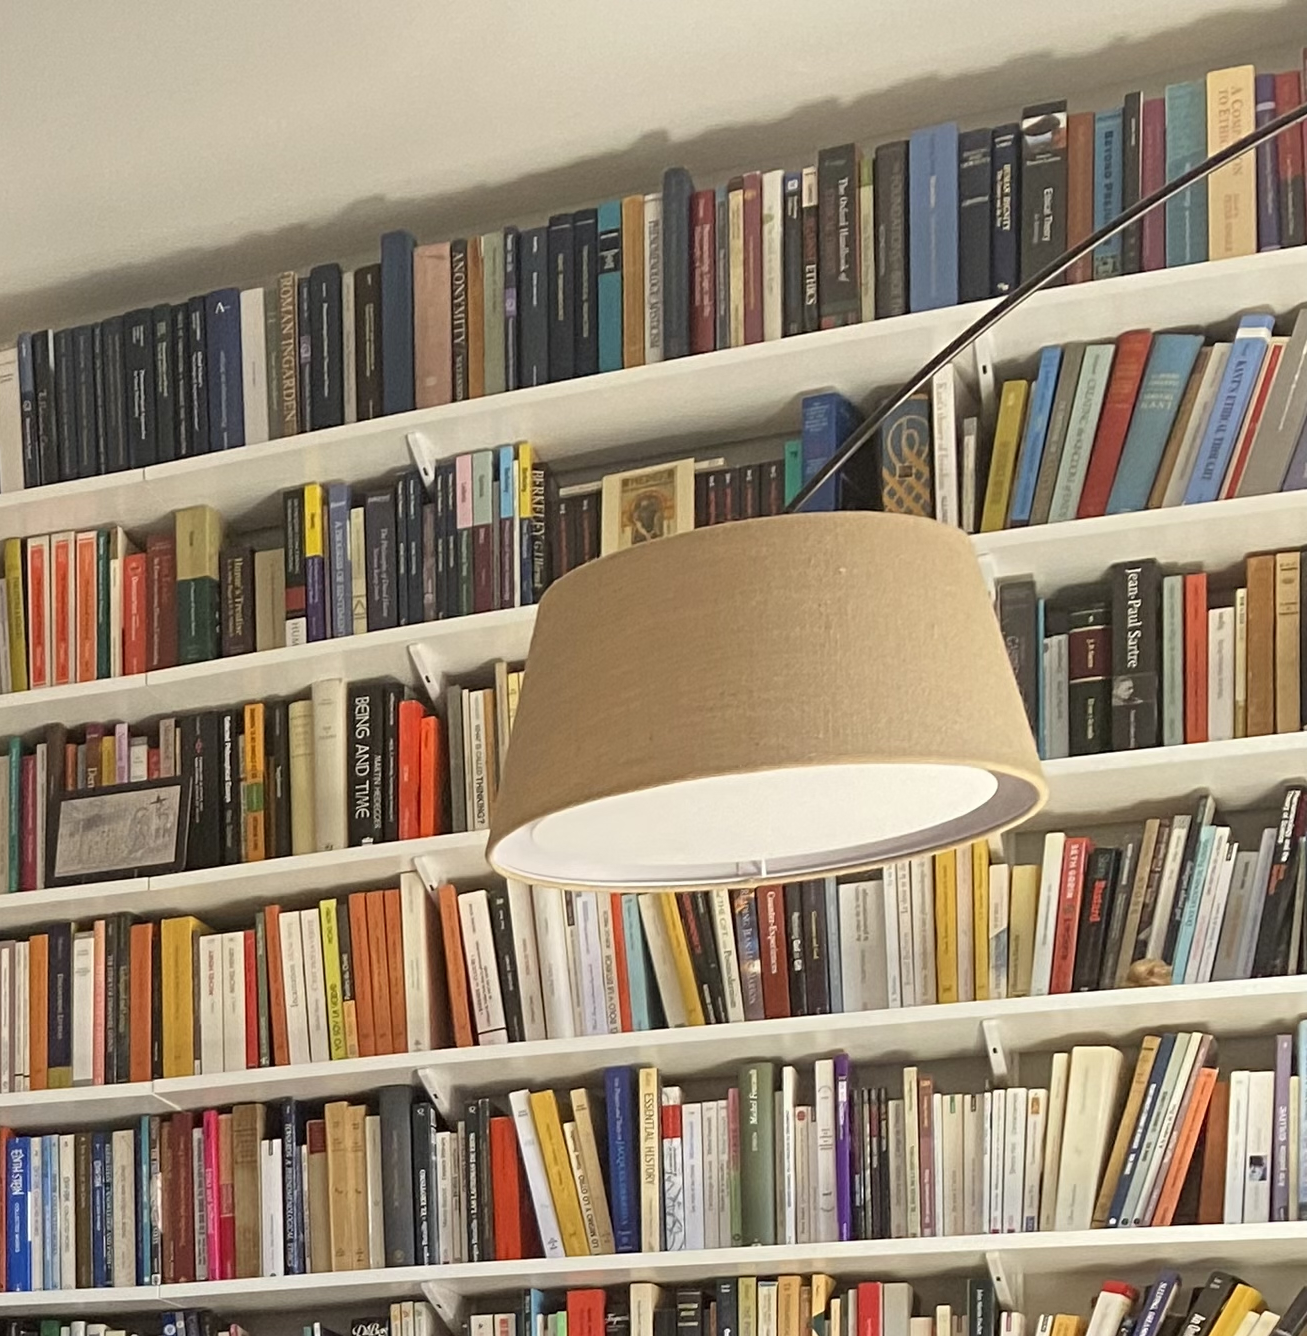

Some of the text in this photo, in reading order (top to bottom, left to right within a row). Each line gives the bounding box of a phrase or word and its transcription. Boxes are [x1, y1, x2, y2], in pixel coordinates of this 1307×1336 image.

[838, 177, 848, 195] The
[1042, 188, 1053, 241] Ethical Theory
[452, 252, 465, 344] ANONYMITY
[806, 264, 817, 306] ETHICS
[280, 277, 296, 421] ROMAN INGARDEN
[1214, 395, 1238, 434] ETHICAL
[1201, 437, 1226, 481] THOUGHT
[532, 470, 545, 539] BERKELEY
[234, 596, 243, 636] Treatise
[1125, 568, 1142, 669] Jean-Paul Sartre
[355, 696, 370, 819] BEING AND TIME
[373, 755, 382, 829] MARTIN HEIDEGGER
[476, 777, 485, 824] THINKING?
[766, 891, 778, 974] Counter-Experiences
[644, 1093, 655, 1185] ESSENTIAL HISTORY
[1190, 1314, 1206, 1324] An
